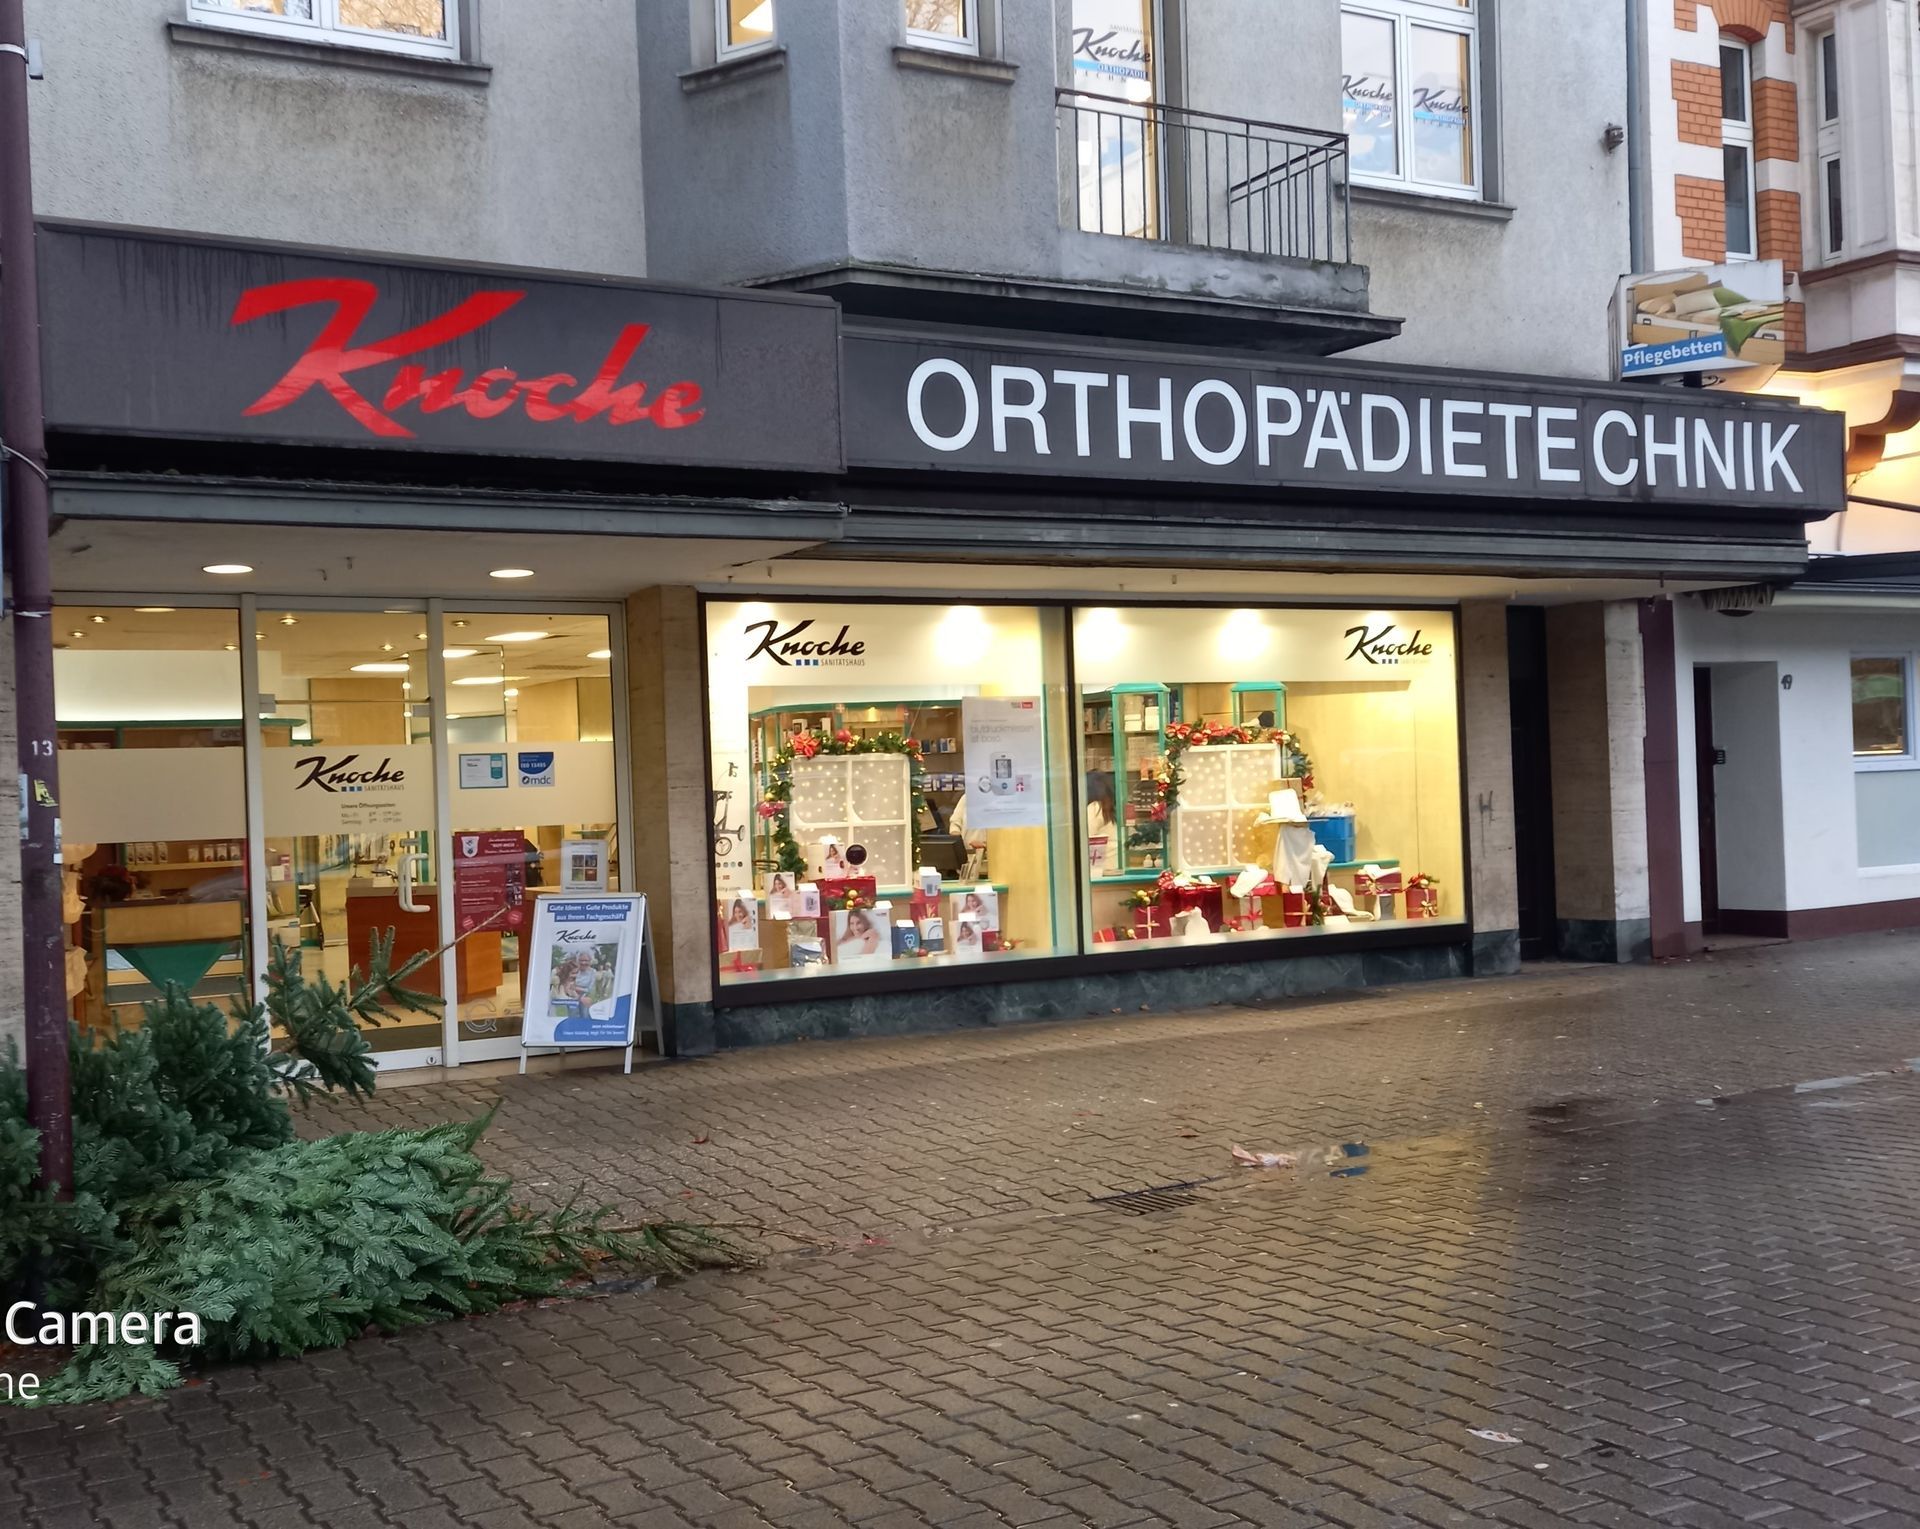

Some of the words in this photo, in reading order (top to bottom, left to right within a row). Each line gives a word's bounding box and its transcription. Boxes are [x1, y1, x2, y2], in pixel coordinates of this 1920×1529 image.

[1072, 28, 1151, 62] Knoche
[1342, 75, 1392, 100] Knoche
[1413, 88, 1468, 113] Knoche
[230, 278, 705, 439] Knoche
[1623, 341, 1723, 367] Pflegebetten
[906, 357, 1803, 493] ORTHOPÄDIETECHNIK
[743, 619, 866, 666] Knoche
[1344, 625, 1432, 664] Knoche
[31, 740, 54, 756] 13
[294, 754, 405, 792] Knoche
[586, 913, 624, 921] Fachgeschäft
[556, 929, 597, 943] Knoche
